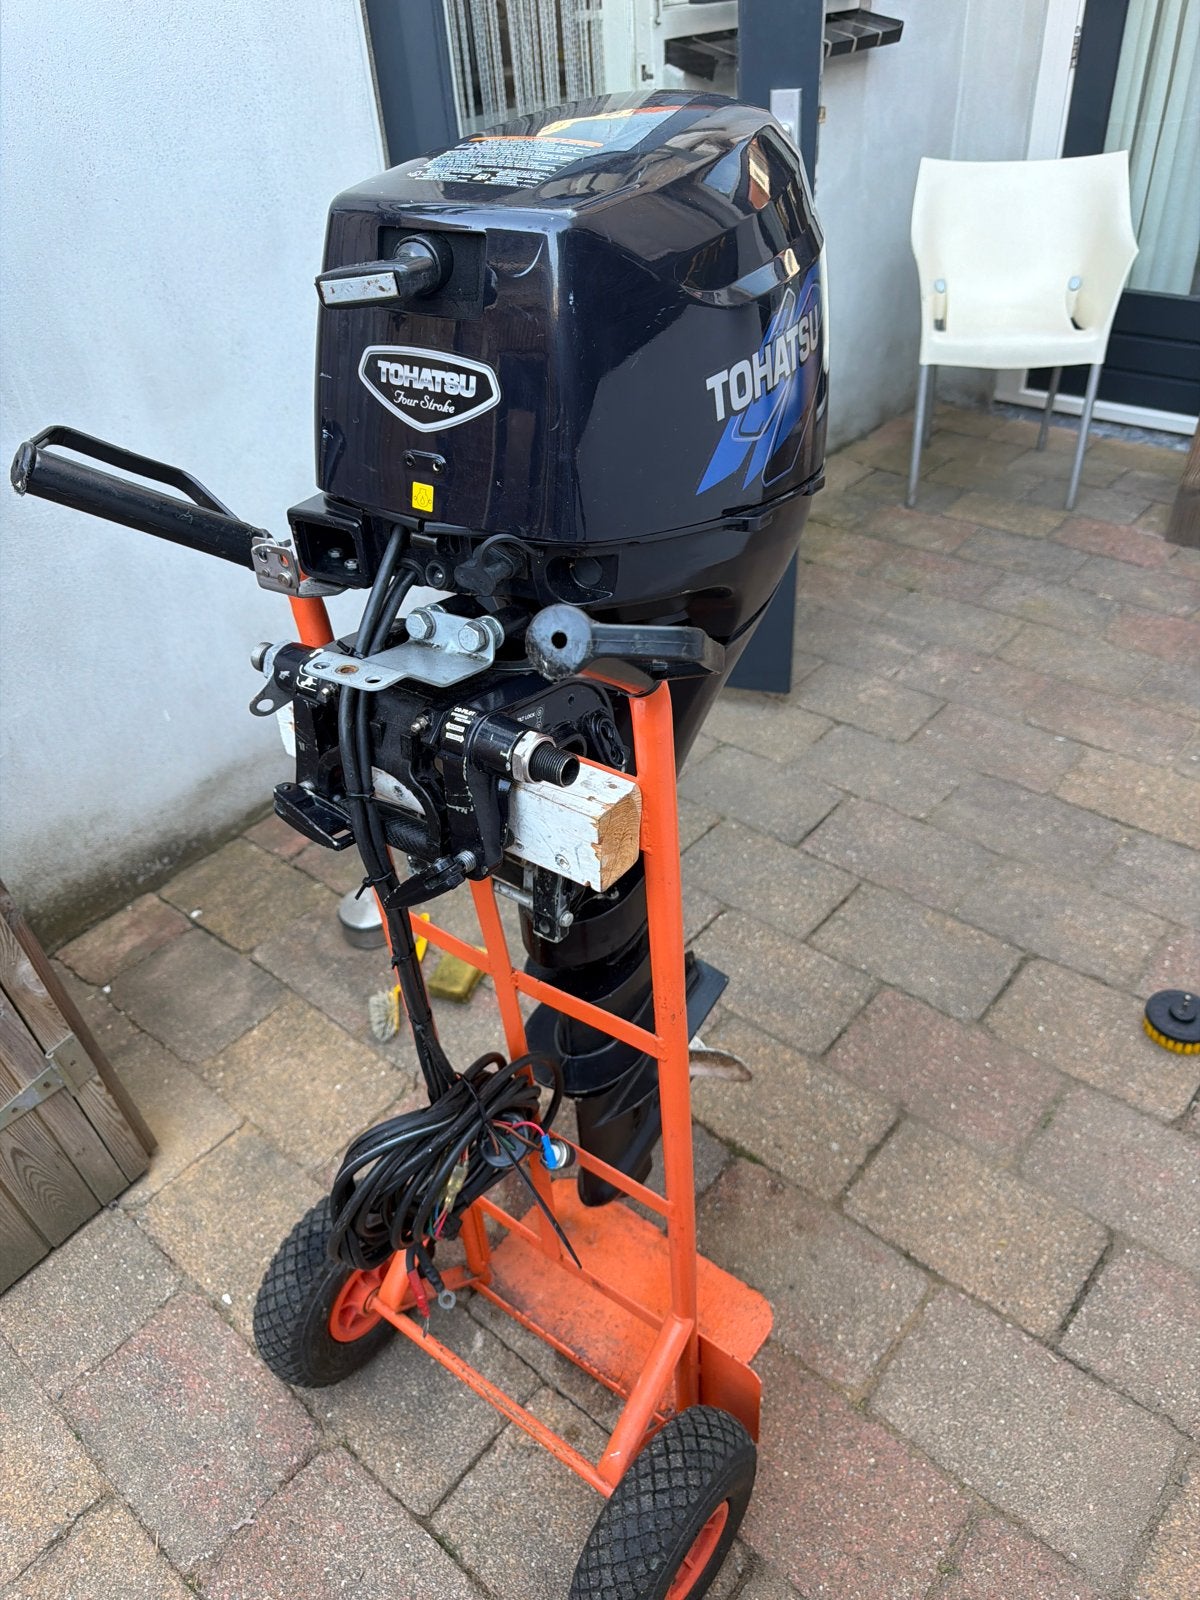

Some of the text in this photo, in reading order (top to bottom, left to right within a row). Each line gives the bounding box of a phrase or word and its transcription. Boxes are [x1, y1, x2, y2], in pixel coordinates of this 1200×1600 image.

[377, 360, 477, 398] TOHATSU
[706, 304, 820, 422] TOHATSU
[393, 390, 455, 414] Four Stroke
